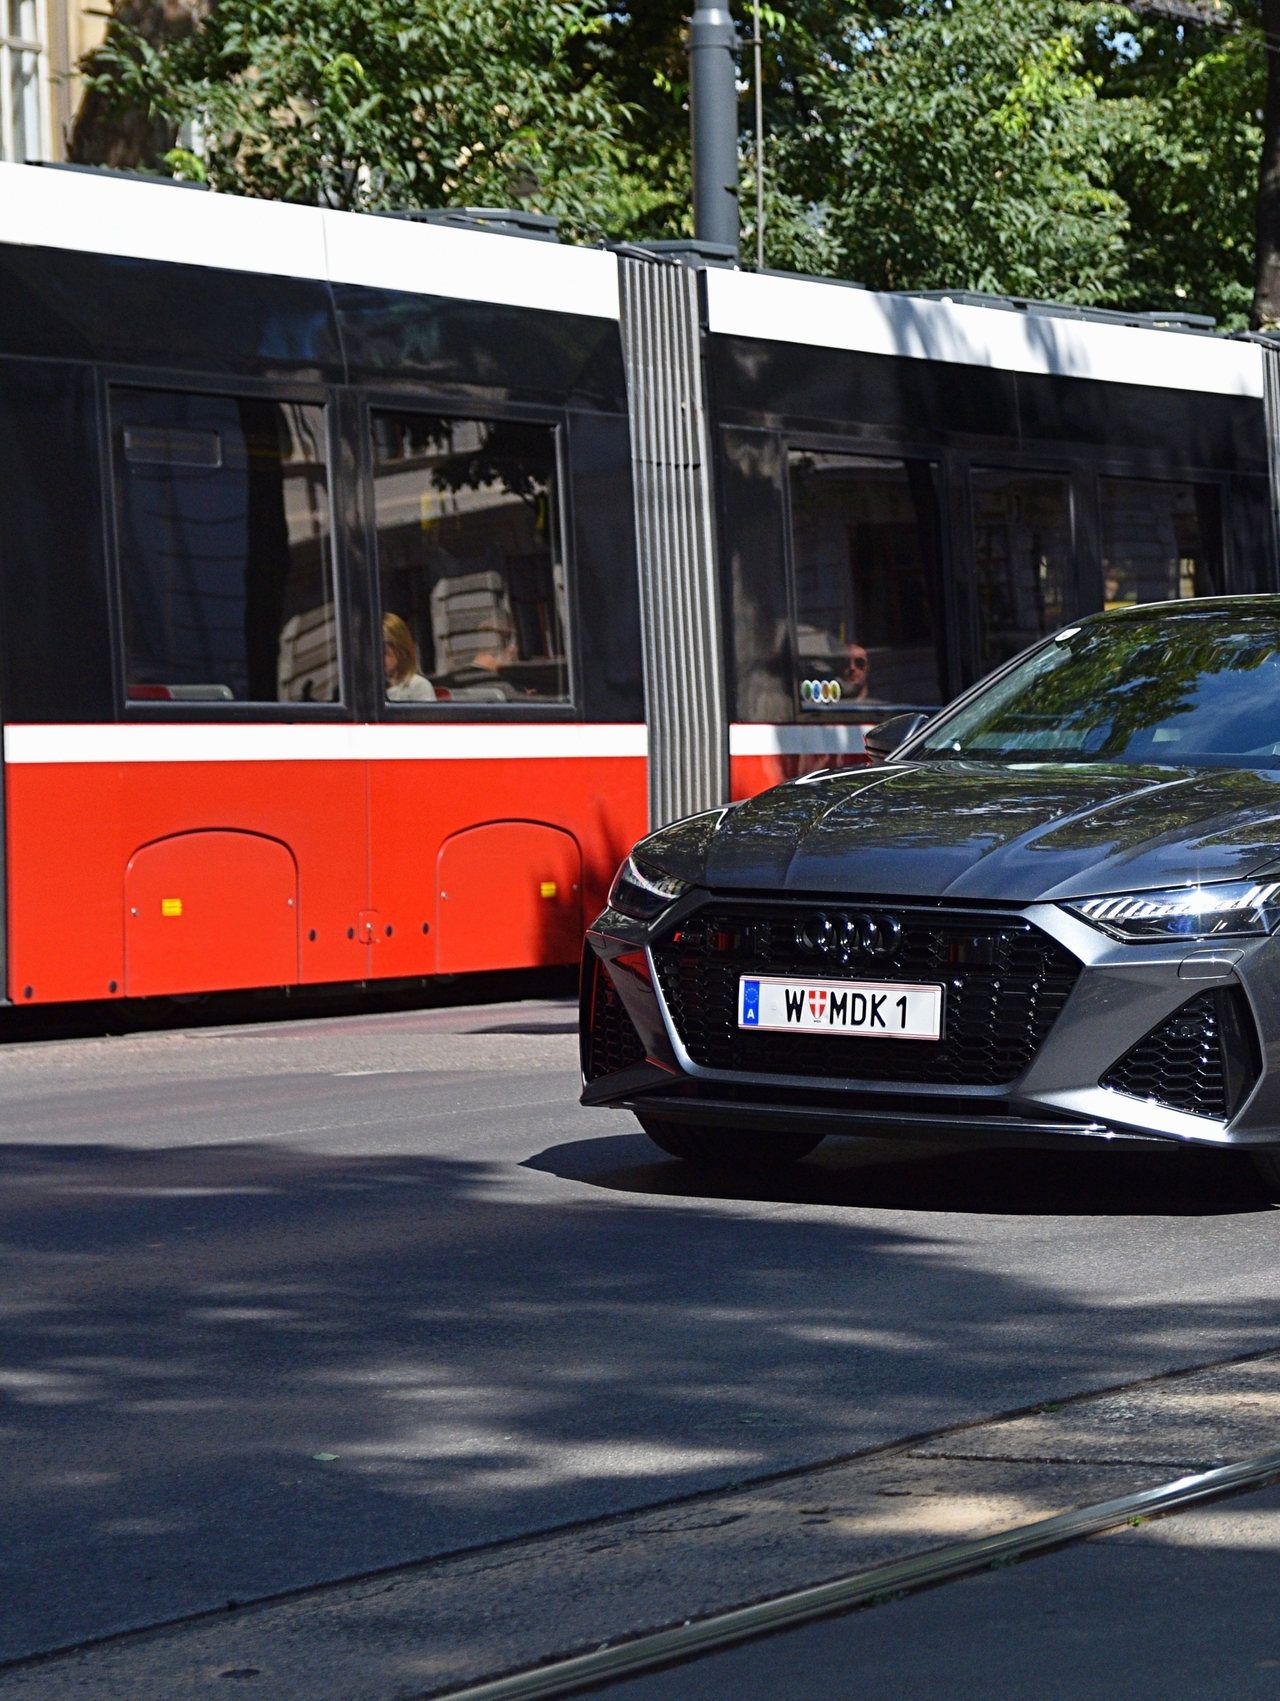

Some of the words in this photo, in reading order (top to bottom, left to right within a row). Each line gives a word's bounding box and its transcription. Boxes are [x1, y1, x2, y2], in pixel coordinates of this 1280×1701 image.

[747, 1008, 755, 1019] A
[785, 988, 805, 1023] W
[829, 991, 887, 1028] MDK
[896, 995, 907, 1029] 1
